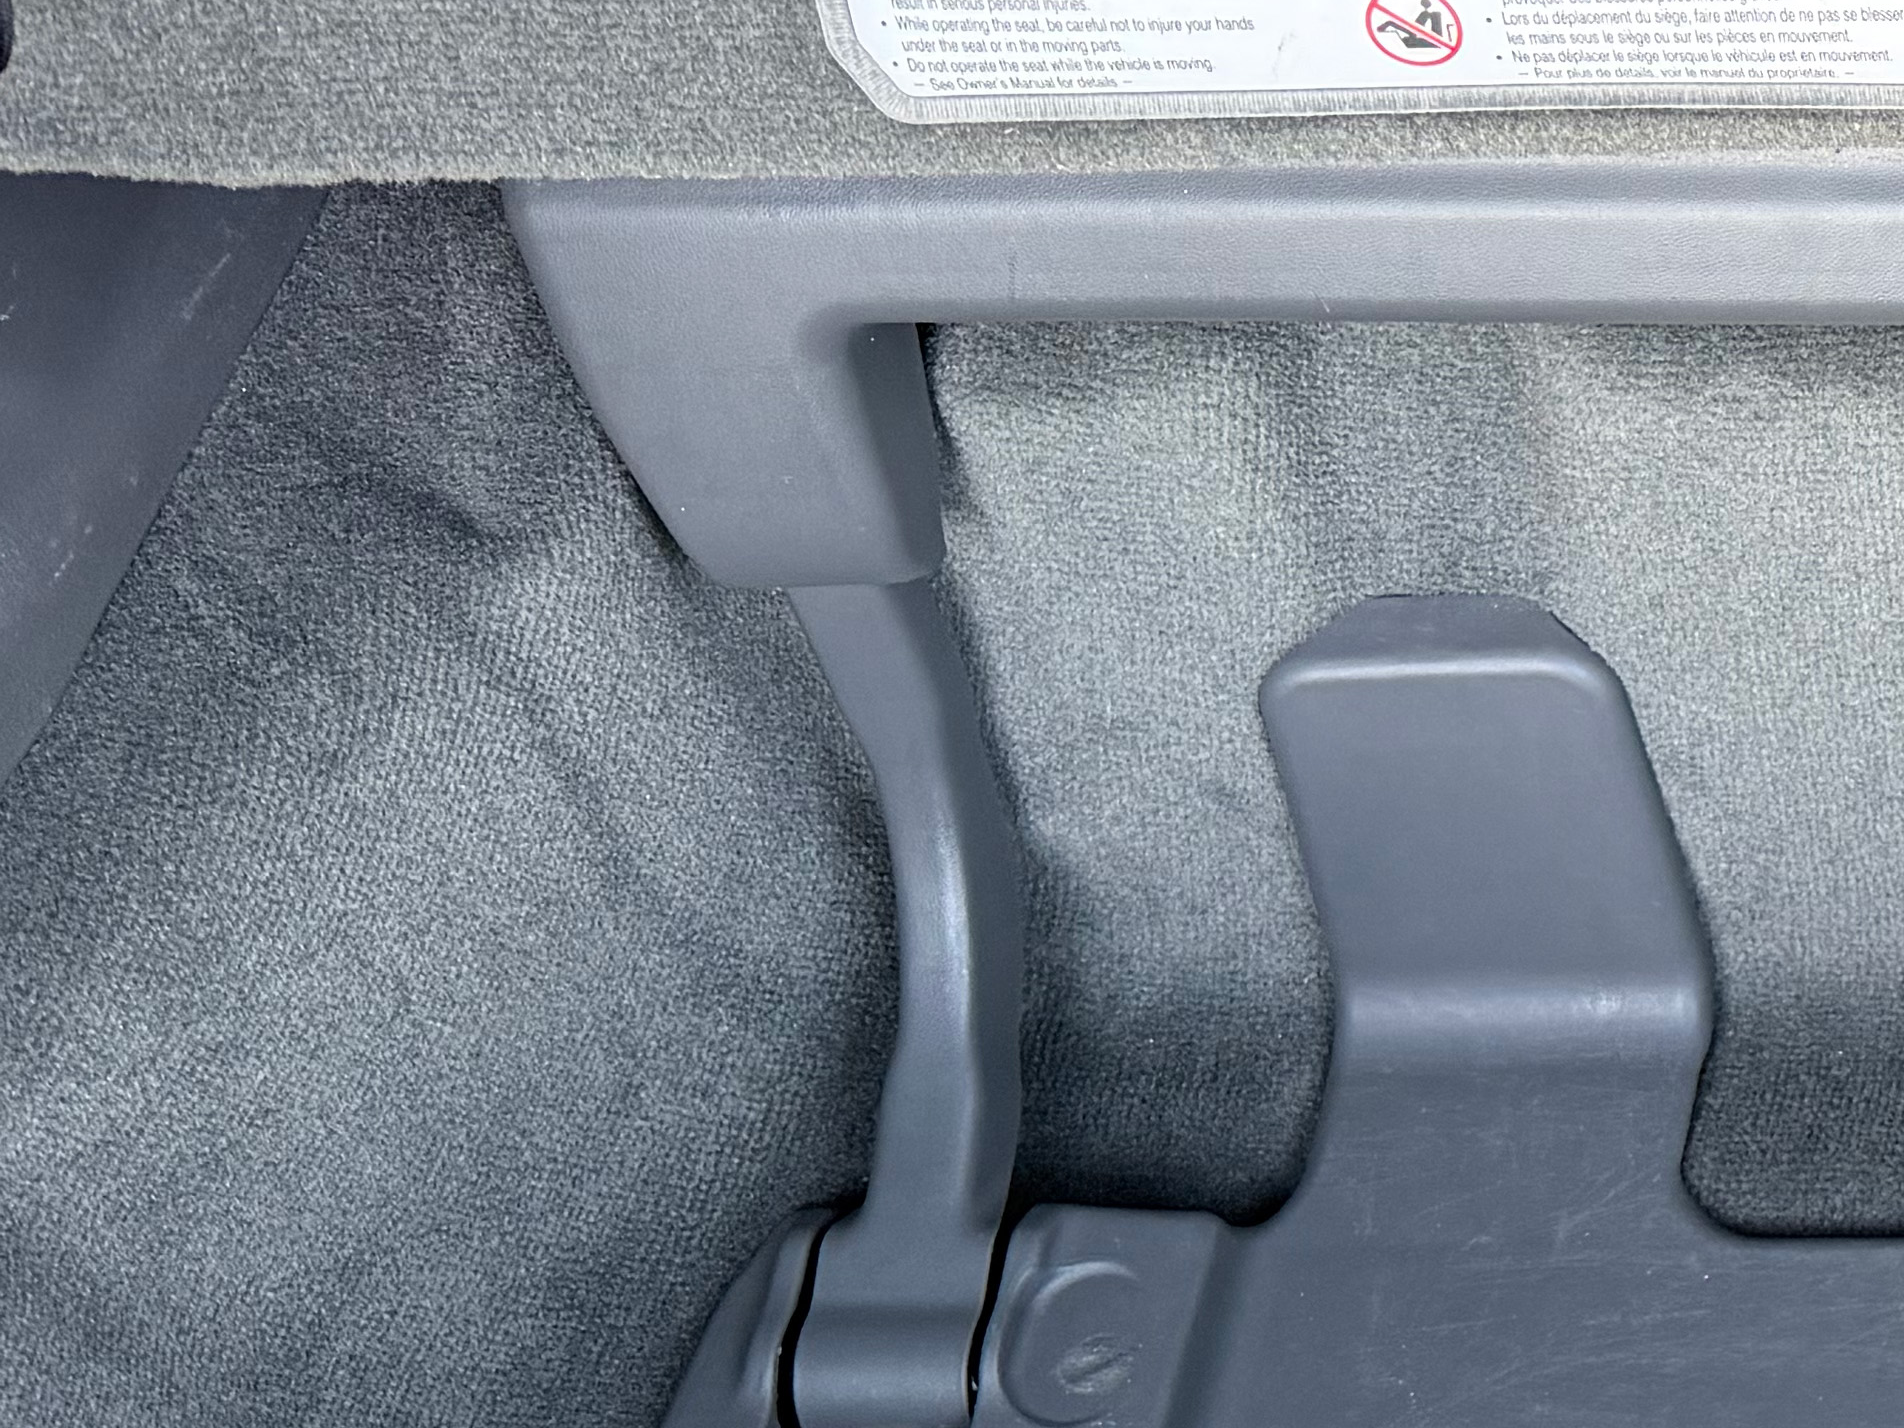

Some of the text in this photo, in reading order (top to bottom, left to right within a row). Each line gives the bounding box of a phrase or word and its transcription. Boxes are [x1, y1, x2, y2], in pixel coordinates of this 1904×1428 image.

[894, 15, 1255, 35] While operating the seat, be careful not to injure your hands
[902, 38, 1125, 55] under the seat or in the moving parts.
[906, 56, 1216, 76] Do not operate the seat while the vehicle is moving.
